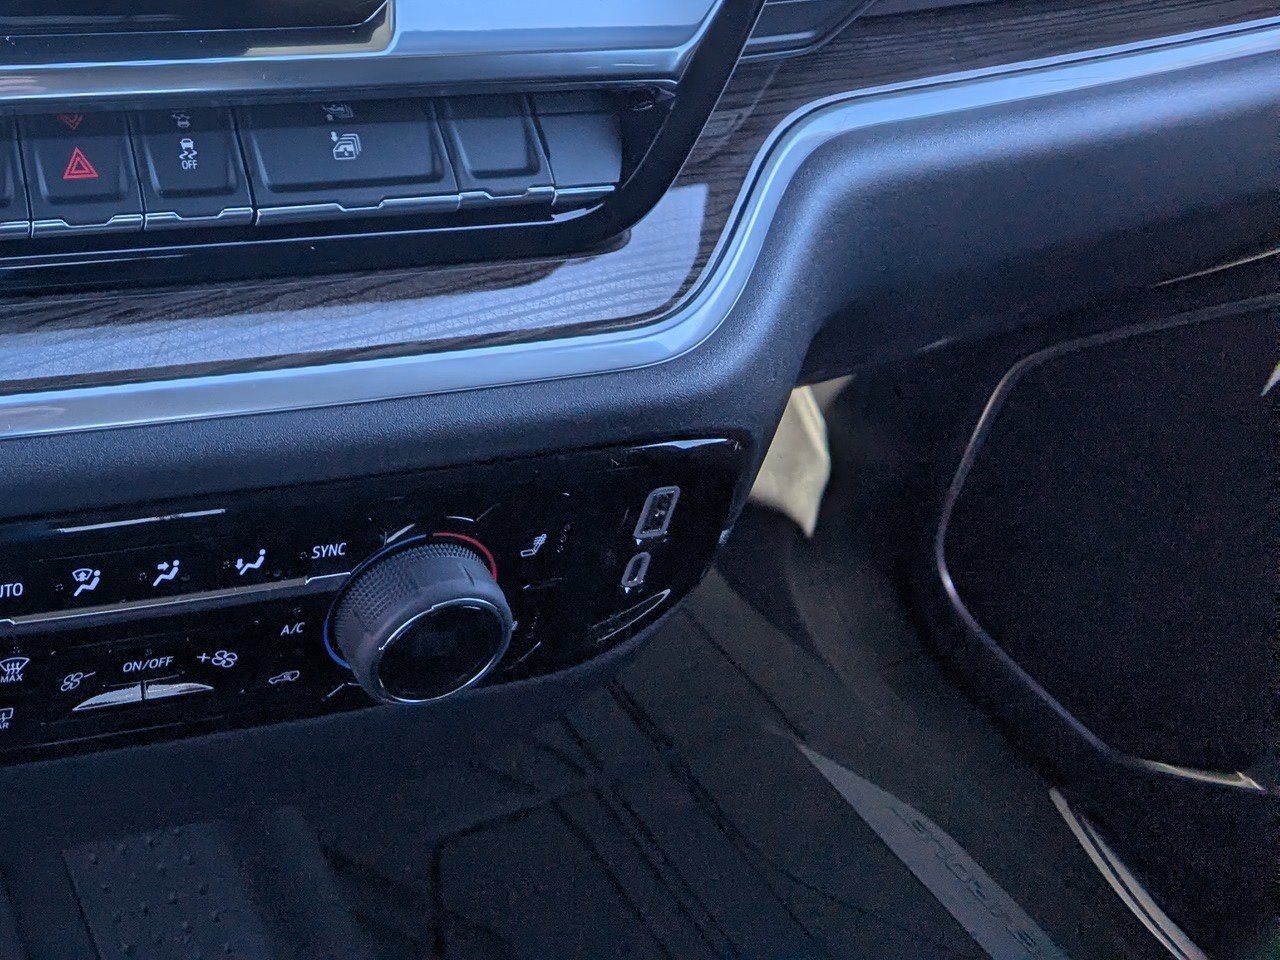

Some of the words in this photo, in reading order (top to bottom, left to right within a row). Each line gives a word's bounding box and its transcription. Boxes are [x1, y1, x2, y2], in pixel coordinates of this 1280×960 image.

[181, 159, 199, 170] OFF
[311, 542, 347, 560] SYNC
[280, 621, 305, 636] A/C
[122, 655, 174, 672] ON/OFF
[0, 672, 23, 684] MAX
